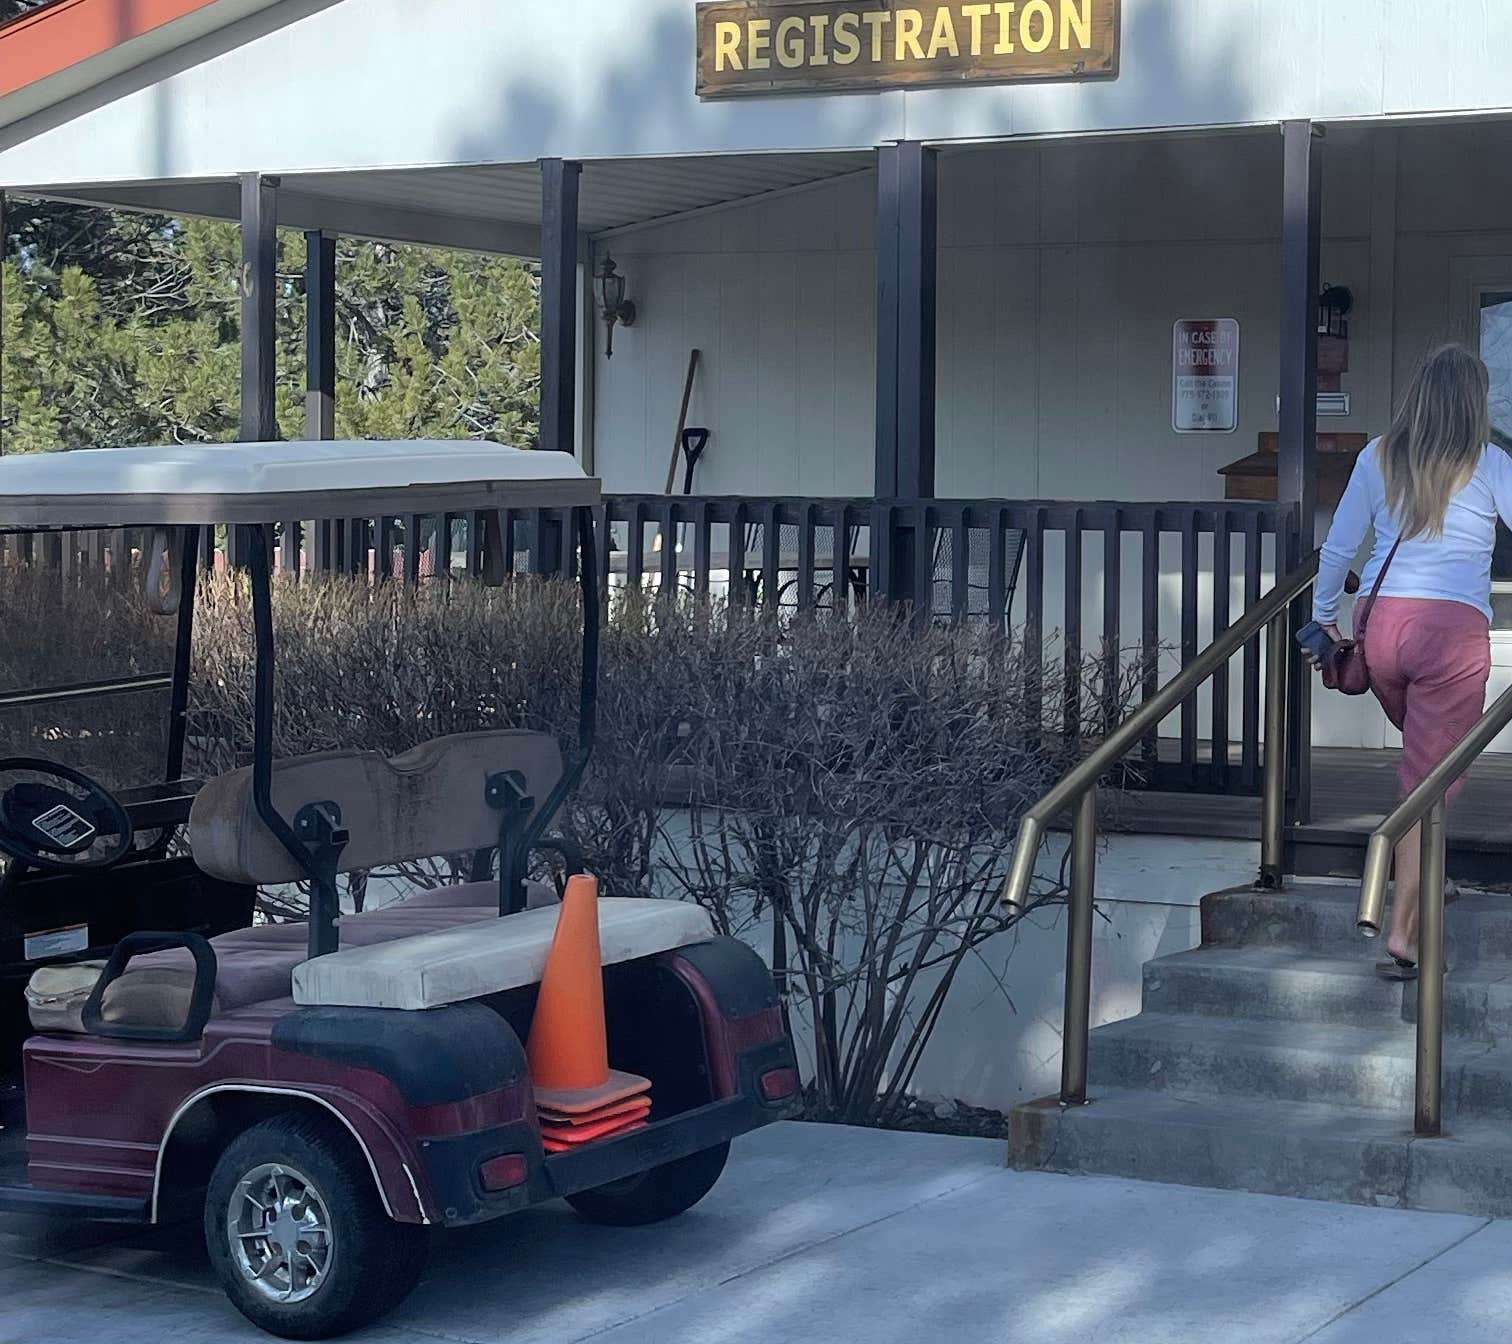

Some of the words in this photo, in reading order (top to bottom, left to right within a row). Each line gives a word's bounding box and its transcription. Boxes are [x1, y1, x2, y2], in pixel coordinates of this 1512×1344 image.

[1178, 331, 1189, 344] IN
[1191, 331, 1216, 344] CASE
[1179, 348, 1233, 366] EMERGENCY
